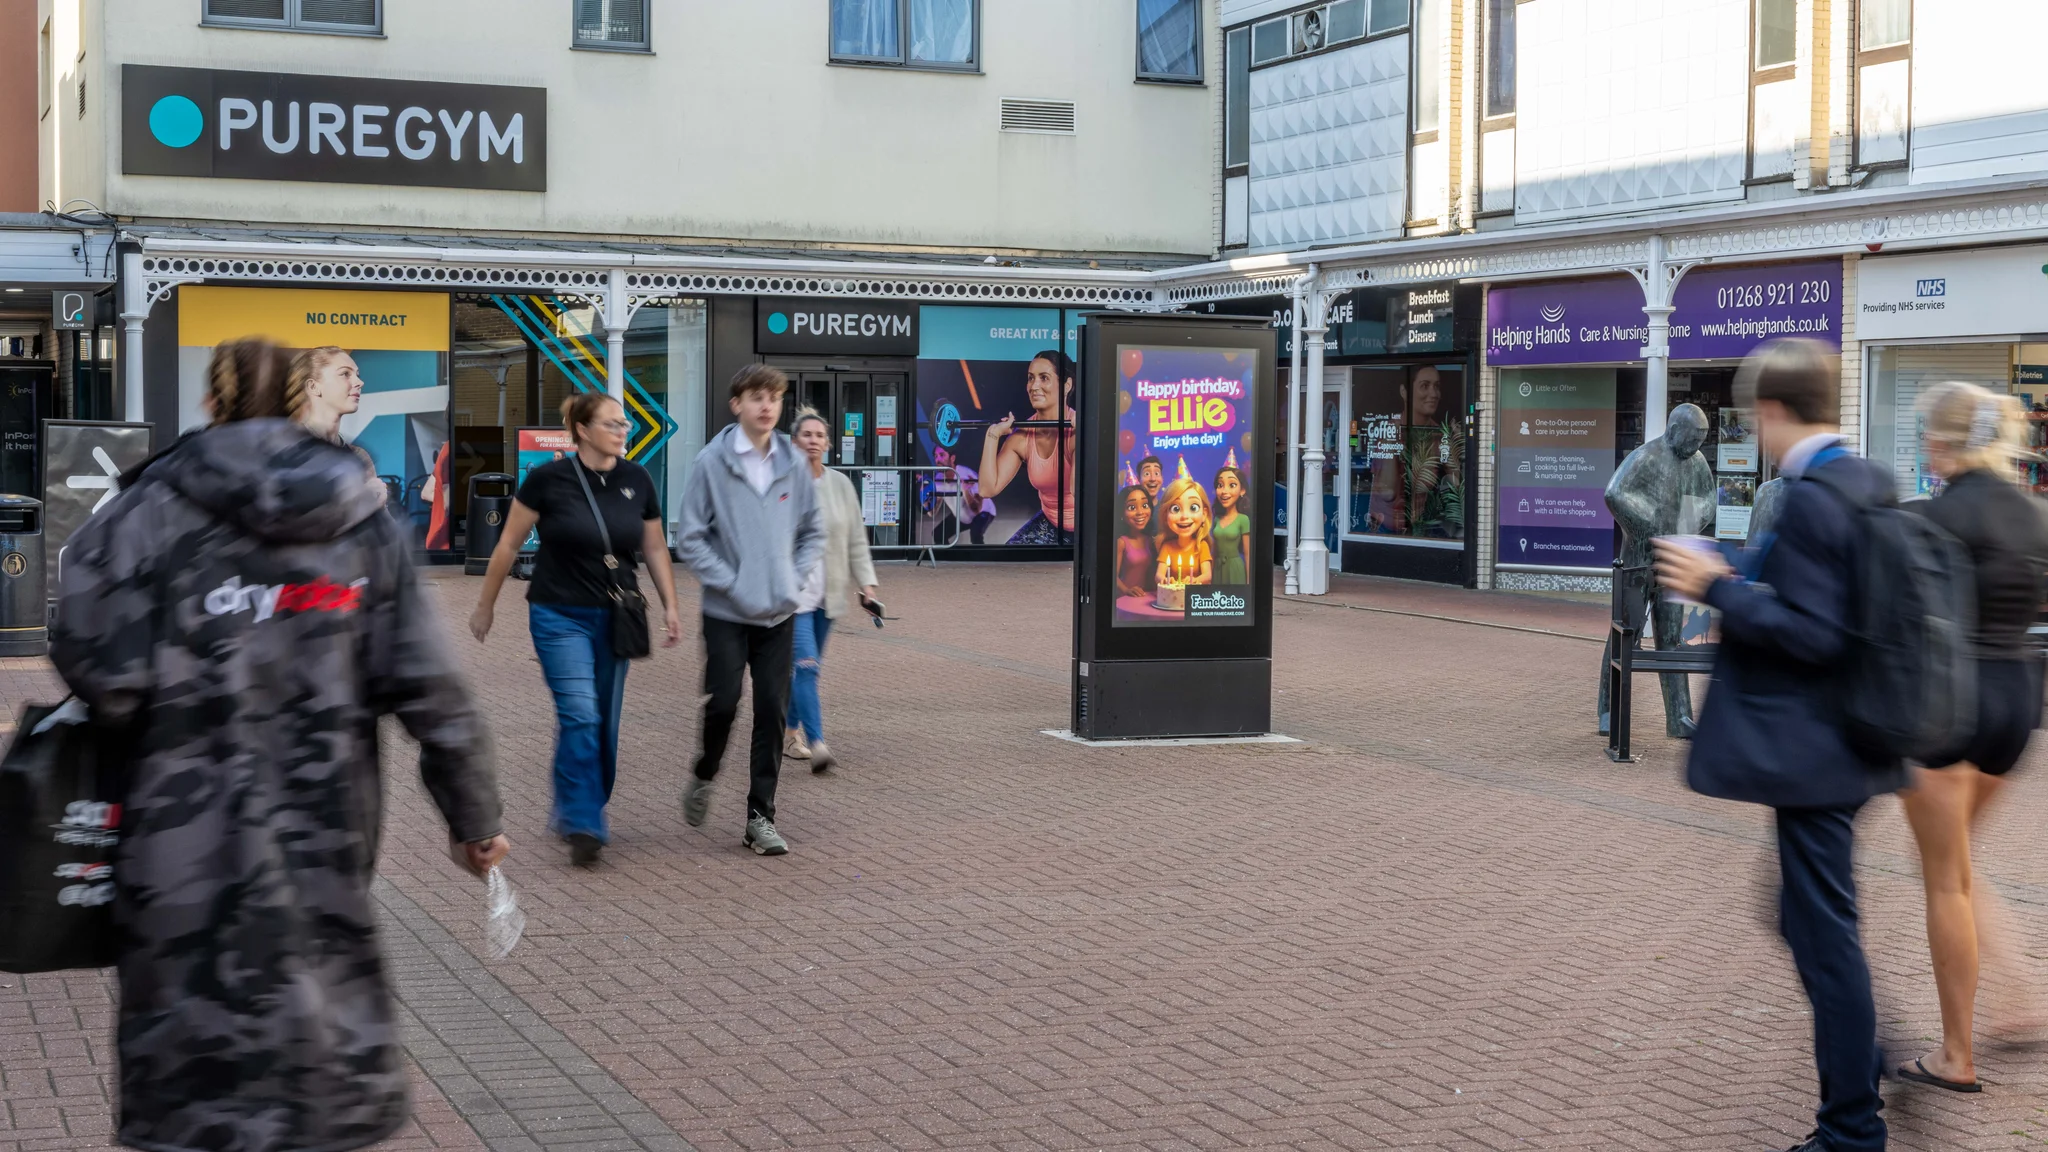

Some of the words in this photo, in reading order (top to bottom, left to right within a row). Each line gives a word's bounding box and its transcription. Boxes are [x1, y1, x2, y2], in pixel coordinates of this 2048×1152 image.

[219, 97, 524, 164] PUREGYM
[1718, 285, 1763, 308] 01268
[1768, 282, 1794, 306] 921
[1801, 280, 1830, 304] 230
[1918, 279, 1944, 296] NHS
[1409, 289, 1450, 306] Breakfast
[1208, 302, 1215, 312] 10
[1863, 302, 1896, 314] Providing
[1898, 301, 1914, 312] NHS
[1916, 300, 1945, 310] services
[306, 312, 326, 324] NO
[330, 313, 407, 326] CONTRACT
[1408, 309, 1434, 324] Lunch
[794, 312, 910, 336] PUREGYM
[1701, 314, 1829, 339] www.helpinghands.co.uk
[990, 328, 1028, 339] GREAT
[1030, 328, 1049, 340] KIT
[1051, 329, 1060, 340] &
[1408, 330, 1437, 344] Dinner
[1492, 326, 1533, 351] Helping
[1535, 322, 1571, 344] Hands
[1580, 327, 1600, 342] Care
[1602, 326, 1610, 341] &
[1612, 324, 1649, 343] Nursing
[2015, 371, 2043, 380] Toiletries
[1137, 380, 1182, 399] Happy
[1182, 377, 1240, 396] birthday,
[1536, 384, 1551, 392] Little
[1559, 384, 1577, 392] Often
[1368, 420, 1397, 439] Coffee
[1535, 419, 1570, 427] One-to-One
[1570, 420, 1597, 428] personal
[1154, 436, 1180, 450] Enjoy
[1181, 434, 1199, 446] the
[1200, 432, 1223, 446] day!
[1370, 450, 1394, 459] Americano
[1534, 455, 1558, 464] Ironing,
[1559, 455, 1586, 464] cleaning,
[1534, 464, 1558, 472] cooking
[1572, 499, 1586, 508] help
[1568, 508, 1596, 517] shopping
[1534, 542, 1560, 550] Branches
[1561, 543, 1595, 552] nationwide
[1190, 594, 1245, 609] FameCake
